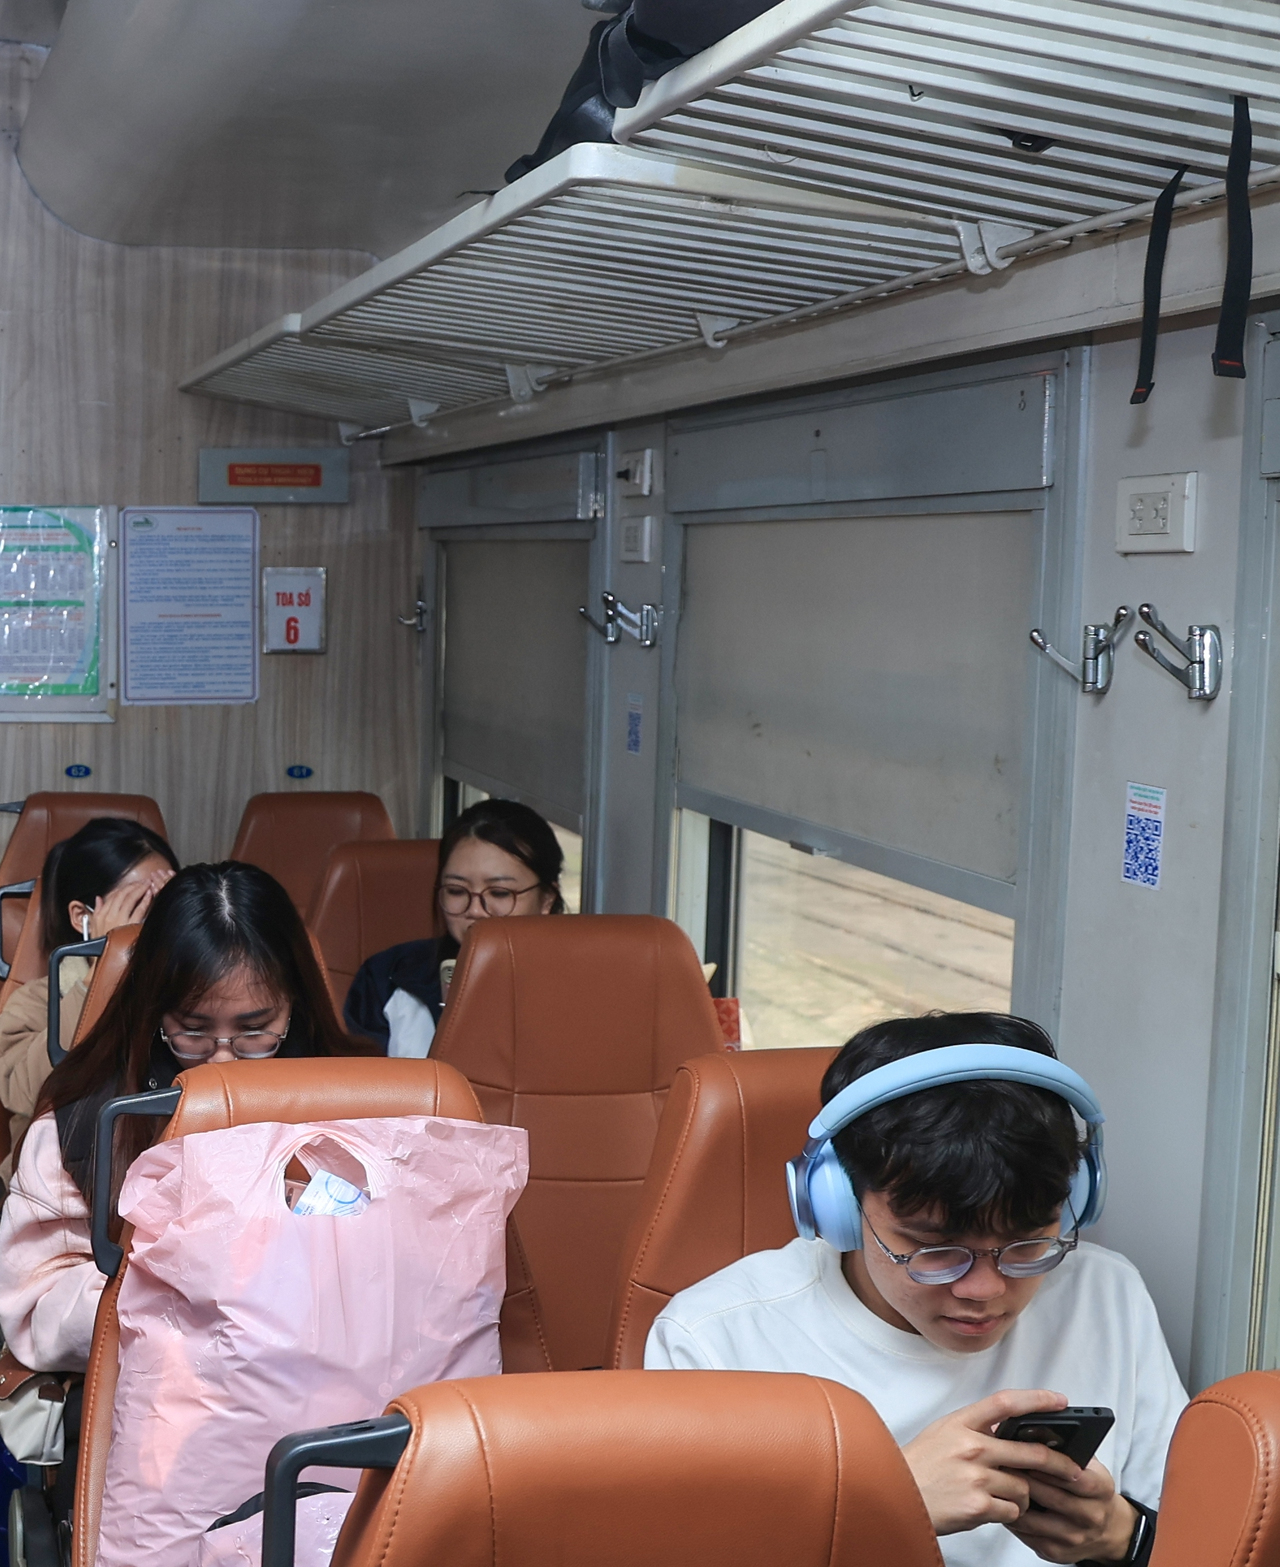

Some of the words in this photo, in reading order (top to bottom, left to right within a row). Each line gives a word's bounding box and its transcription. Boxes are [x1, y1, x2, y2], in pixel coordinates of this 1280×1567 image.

[276, 591, 294, 607] TOA
[297, 587, 312, 607] SỐ
[286, 616, 300, 645] 6
[71, 767, 86, 776] 62
